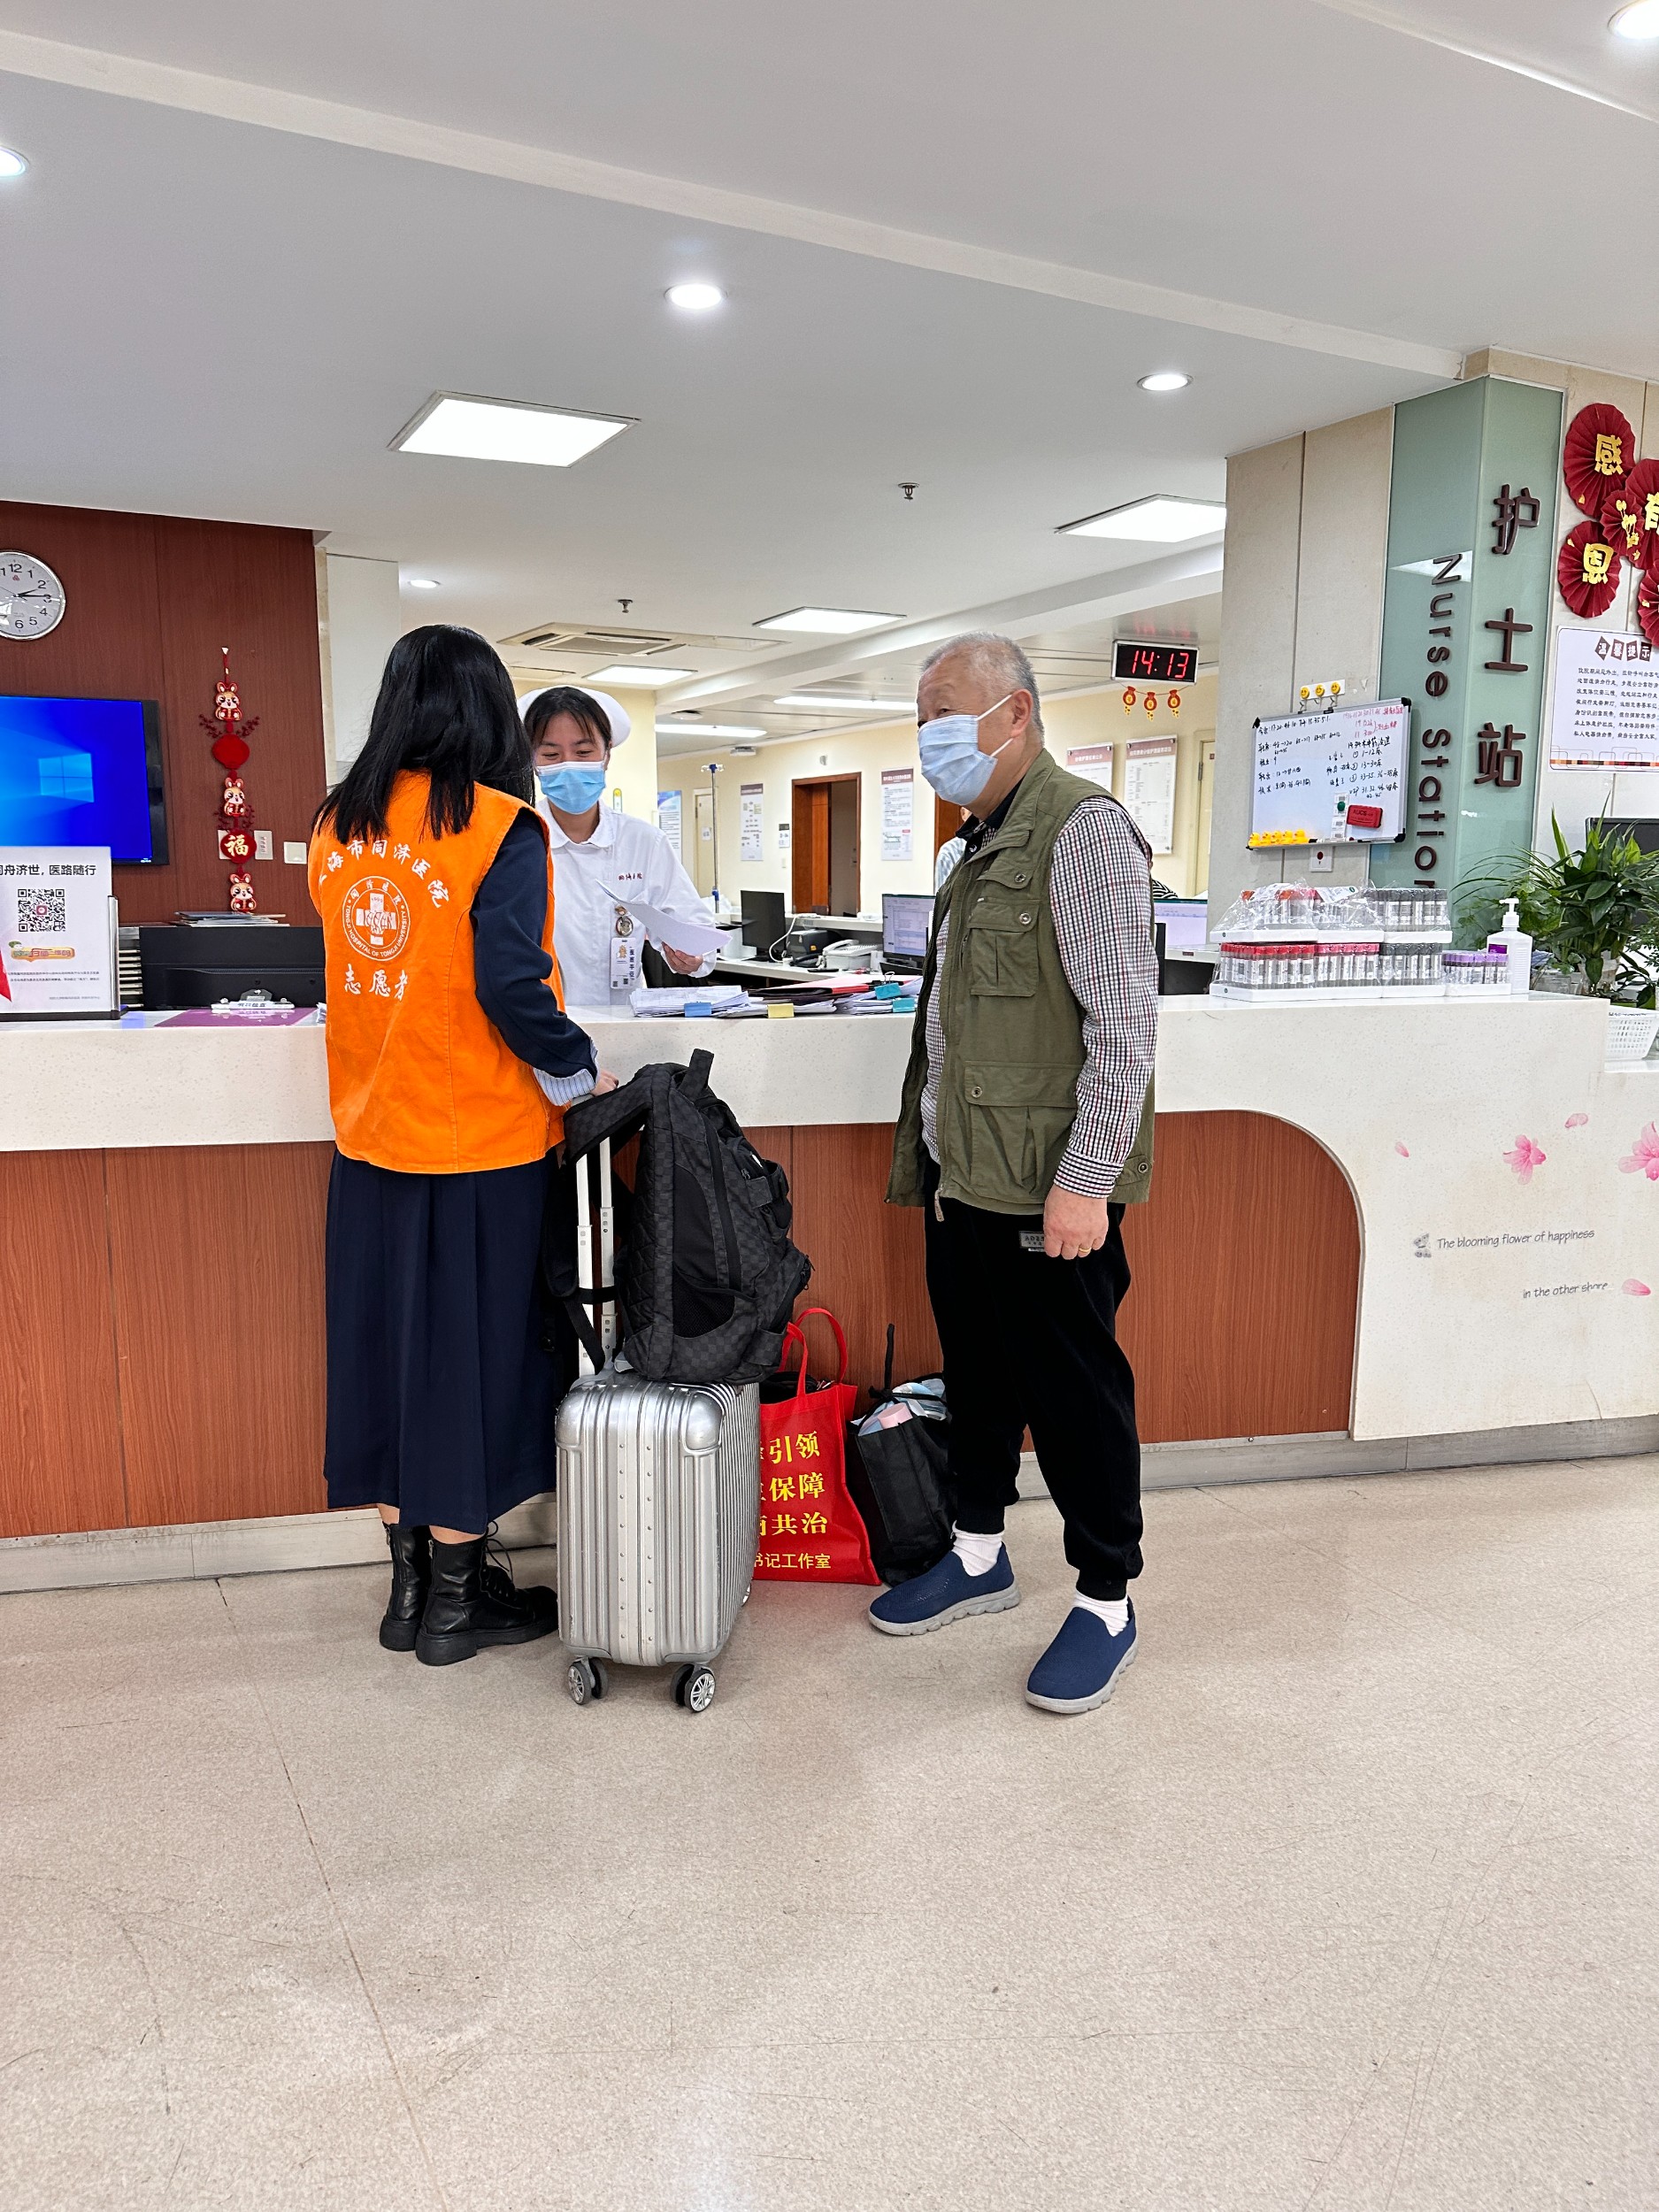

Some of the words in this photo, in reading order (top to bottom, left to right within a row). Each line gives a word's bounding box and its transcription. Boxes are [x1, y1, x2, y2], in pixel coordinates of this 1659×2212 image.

[1594, 434, 1624, 475] 感
[8, 564, 22, 573] 12
[1582, 542, 1614, 584] 恩
[27, 570, 33, 579] 1
[37, 580, 46, 589] 2
[15, 620, 24, 629] 6
[29, 617, 37, 626] 5
[1425, 553, 1463, 696] Nurse
[1475, 484, 1540, 787] 护士站
[1599, 641, 1650, 658] 温馨提示
[1132, 649, 1189, 679] 14:13
[224, 834, 249, 856] 福
[344, 963, 408, 1002] 志愿者
[1437, 1238, 1455, 1248] The
[1457, 1234, 1499, 1248] blooming
[1502, 1233, 1532, 1245] flower
[1534, 1231, 1546, 1241] of
[1548, 1229, 1594, 1244] happiness
[1523, 1288, 1532, 1298] in
[1534, 1286, 1550, 1297] the
[1553, 1284, 1579, 1295] other
[759, 1430, 820, 1464] 引领
[759, 1472, 826, 1502] 保障
